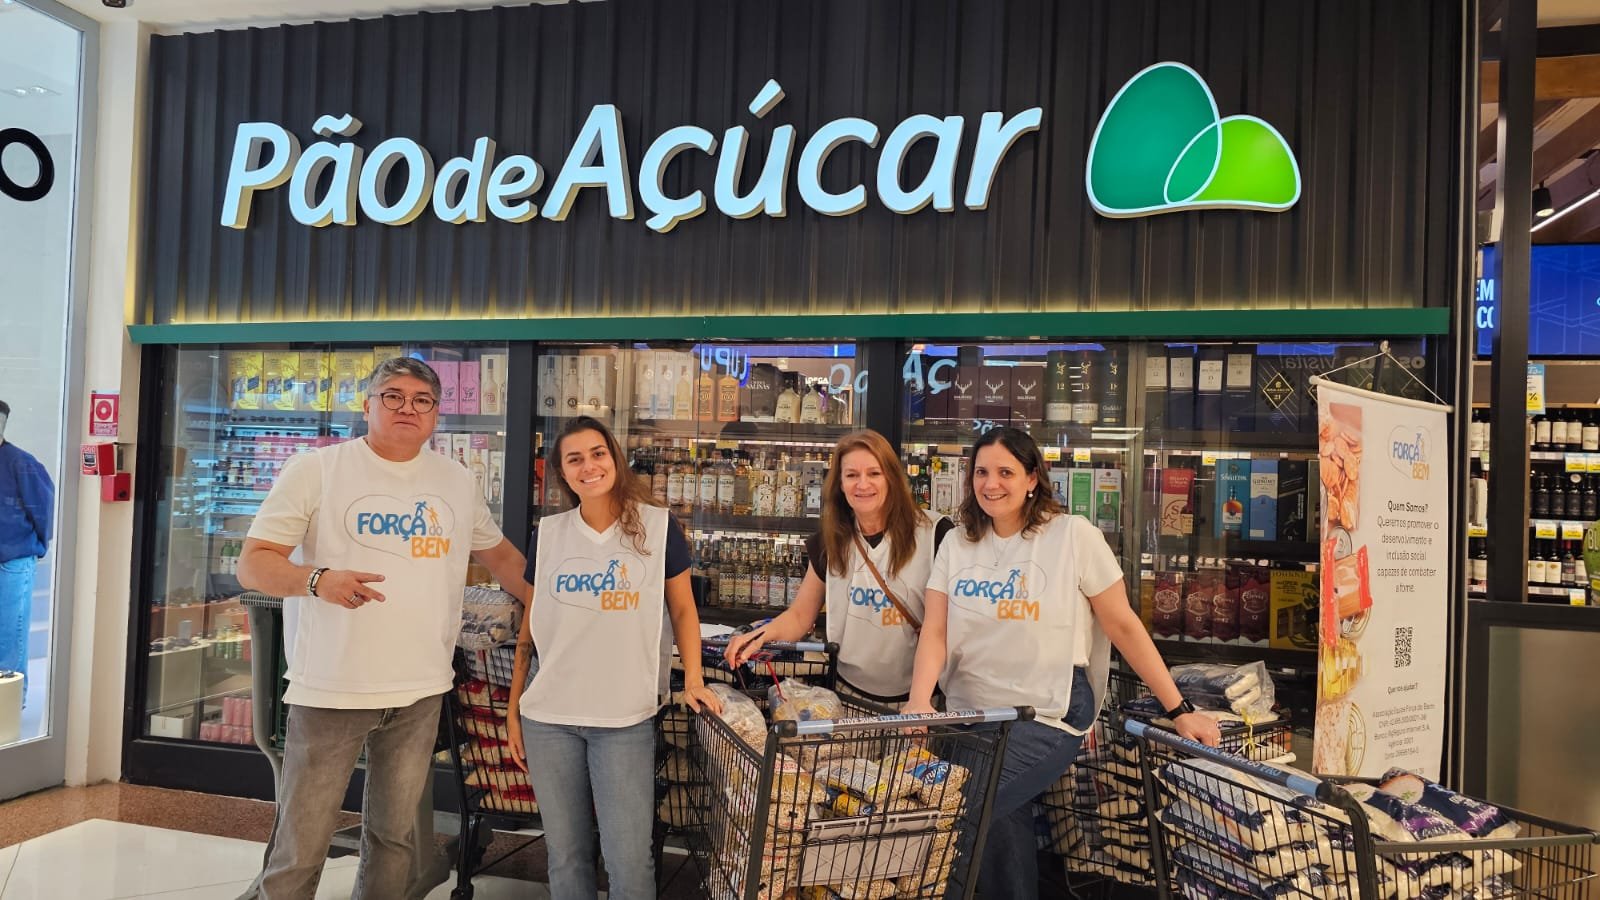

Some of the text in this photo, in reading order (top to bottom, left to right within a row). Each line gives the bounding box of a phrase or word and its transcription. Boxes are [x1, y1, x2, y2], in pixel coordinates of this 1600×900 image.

[220, 79, 1043, 234] Pão de Açúcar
[1393, 441, 1420, 465] FORÇA
[1412, 463, 1430, 480] BEM
[1388, 500, 1405, 512] Quem
[357, 511, 427, 542] FORÇA
[556, 571, 616, 596] FORÇA
[954, 579, 1015, 604] FORÇA
[600, 591, 640, 611] BEM
[997, 599, 1041, 622] BEM
[881, 608, 905, 626] BE
